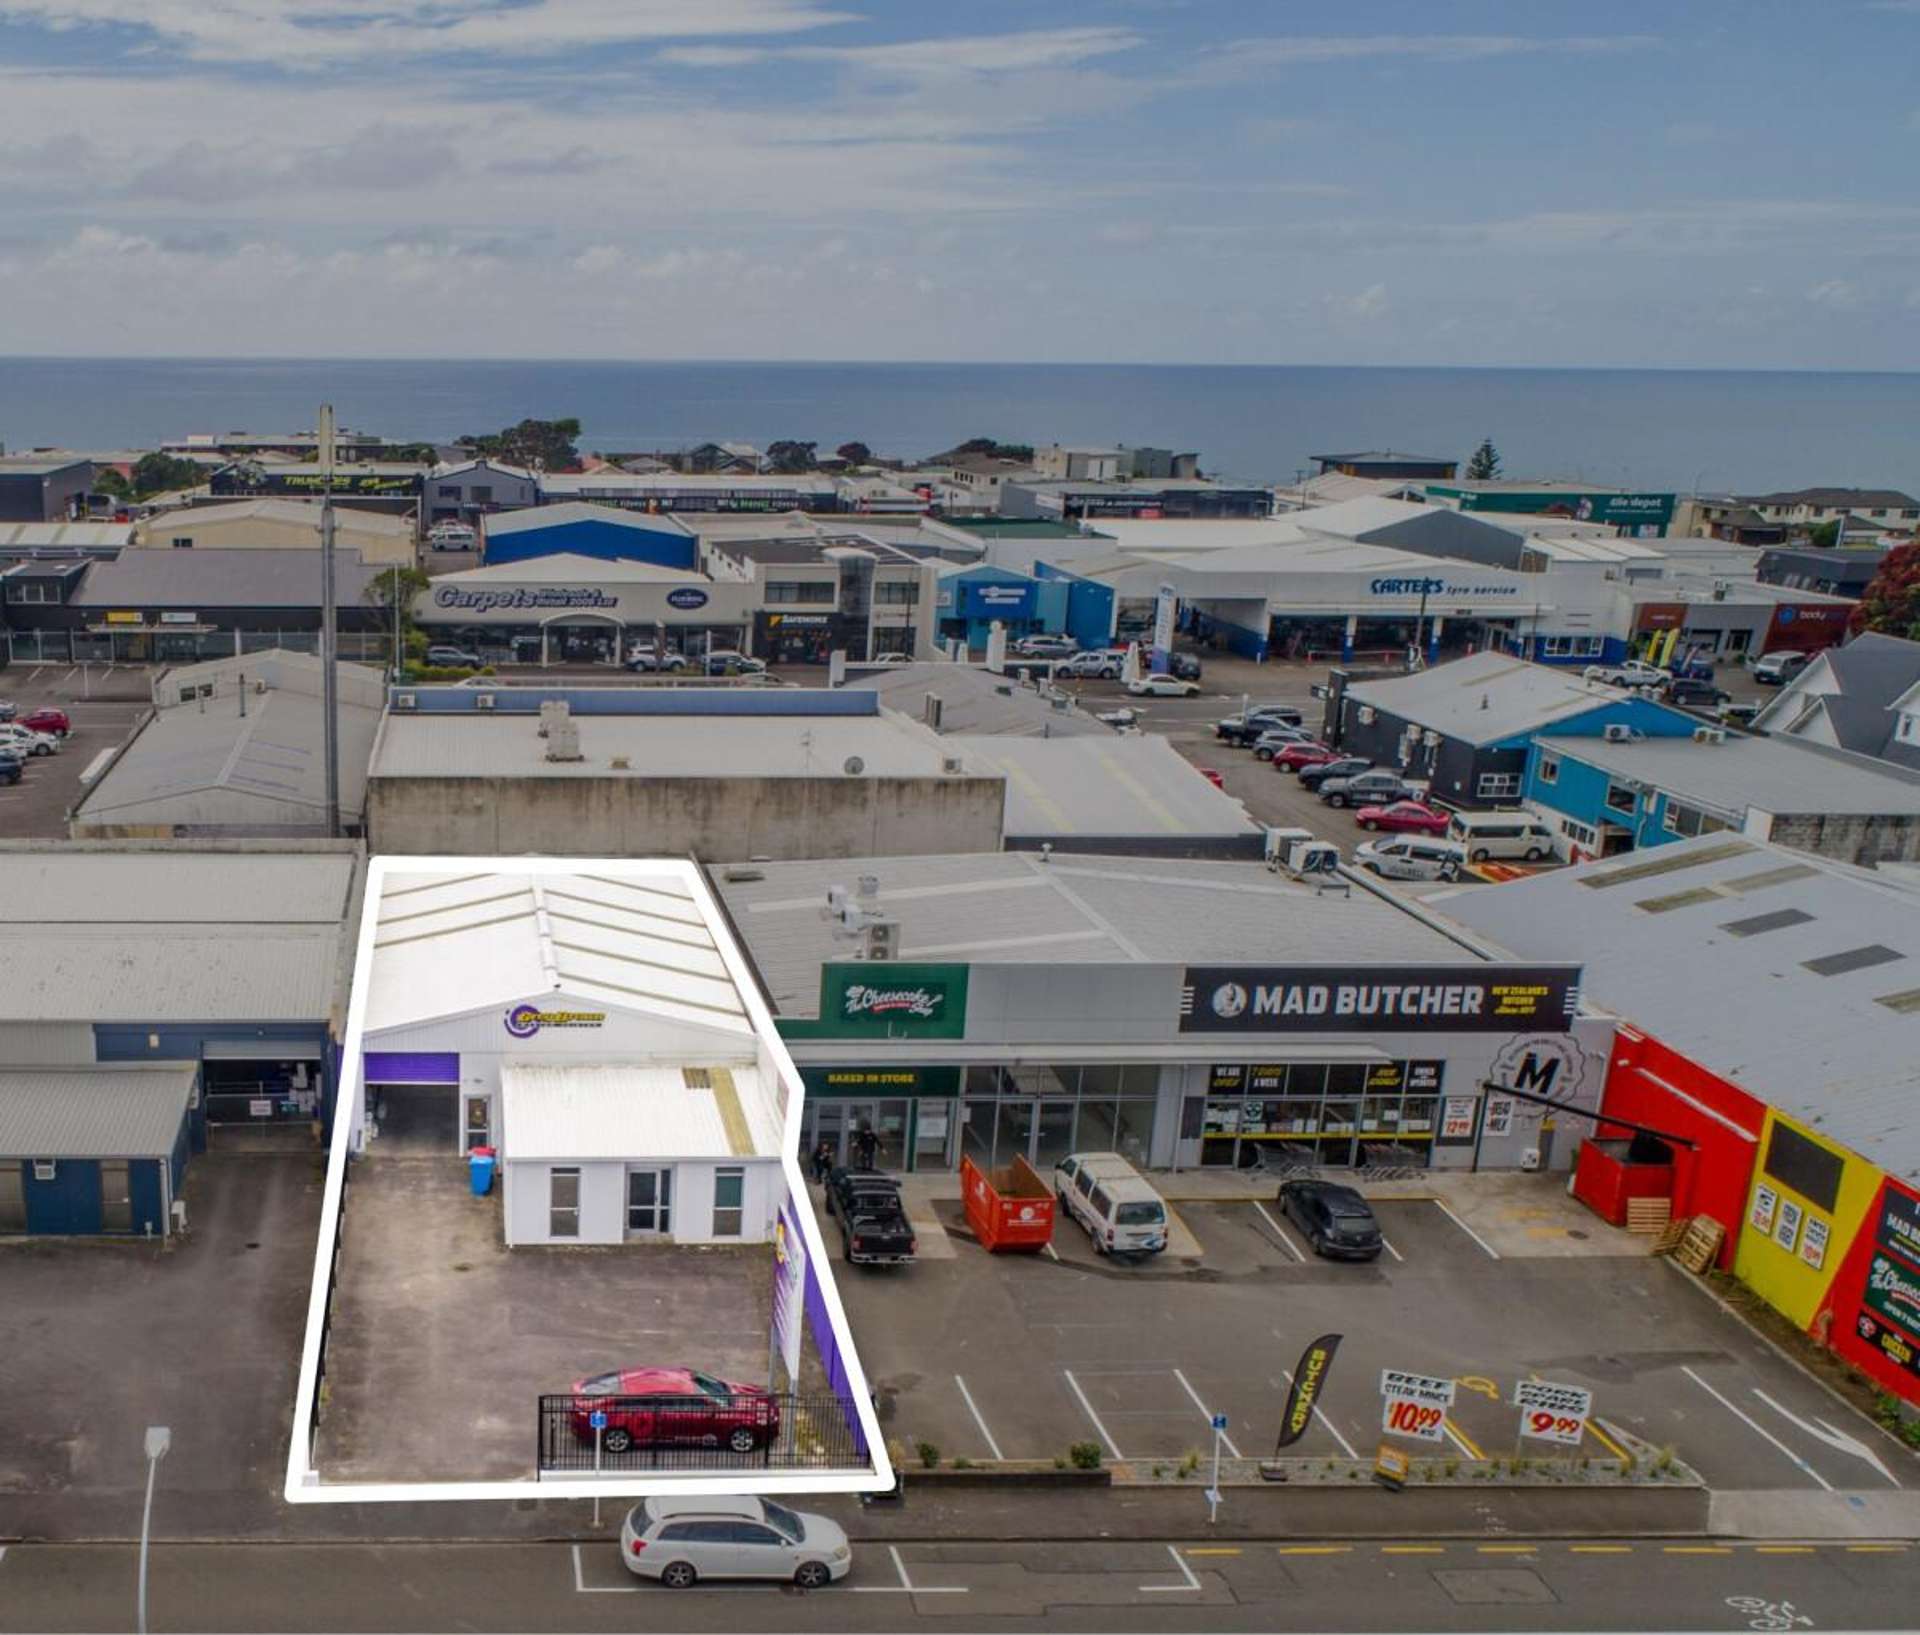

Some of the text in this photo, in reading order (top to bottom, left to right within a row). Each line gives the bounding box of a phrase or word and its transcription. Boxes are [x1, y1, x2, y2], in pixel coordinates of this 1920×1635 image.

[435, 585, 538, 613] Carpets
[1253, 985, 1484, 1014] MAD BUTCHER
[1514, 1052, 1561, 1094] M
[1290, 1348, 1328, 1434] BUTCHERY
[1387, 1373, 1450, 1389] BEEF
[1521, 1384, 1588, 1398] PORK
